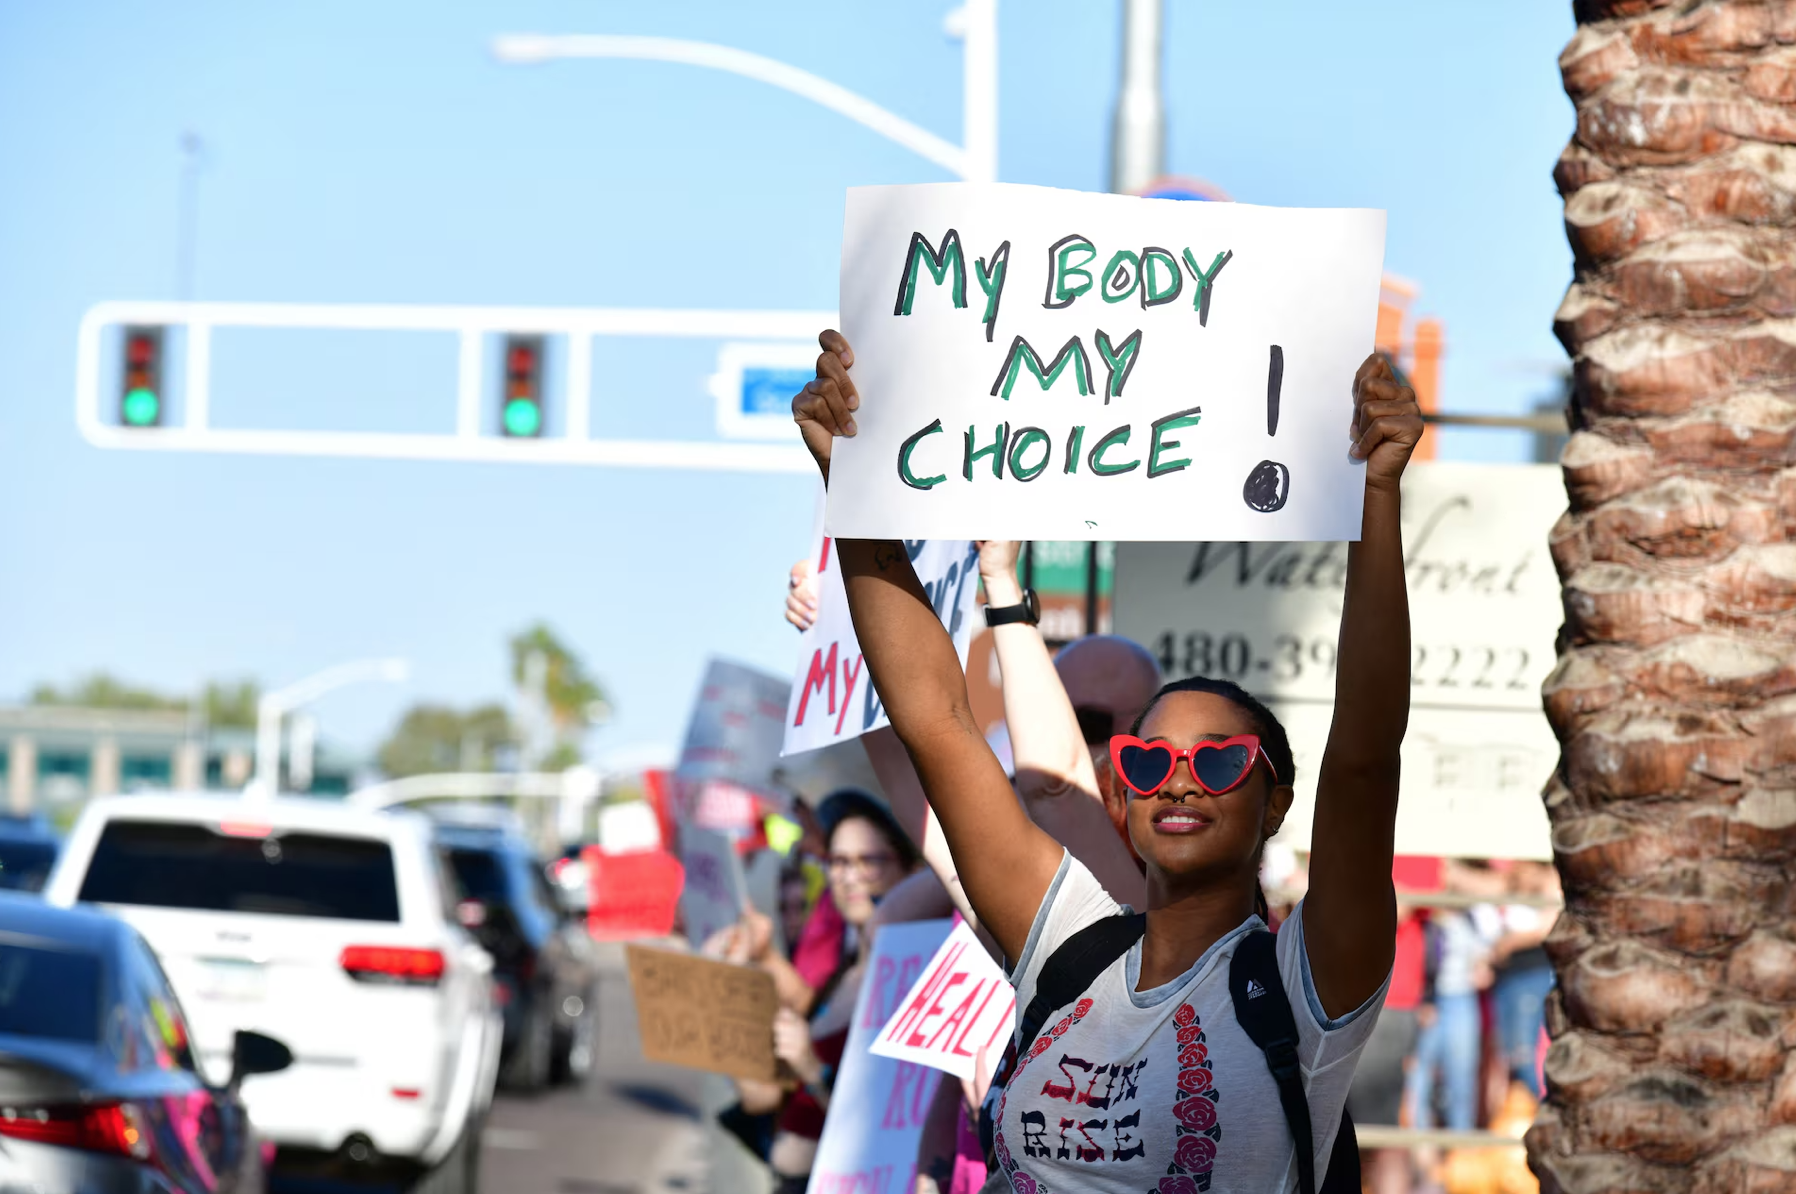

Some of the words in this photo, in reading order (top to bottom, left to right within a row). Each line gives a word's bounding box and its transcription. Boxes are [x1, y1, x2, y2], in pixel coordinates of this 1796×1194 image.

[894, 228, 1011, 342] My
[1042, 233, 1233, 327] BODY
[990, 328, 1143, 405] MY
[897, 406, 1202, 490] CHOICE
[1040, 1053, 1148, 1111] SUN
[1020, 1109, 1145, 1163] RISE
